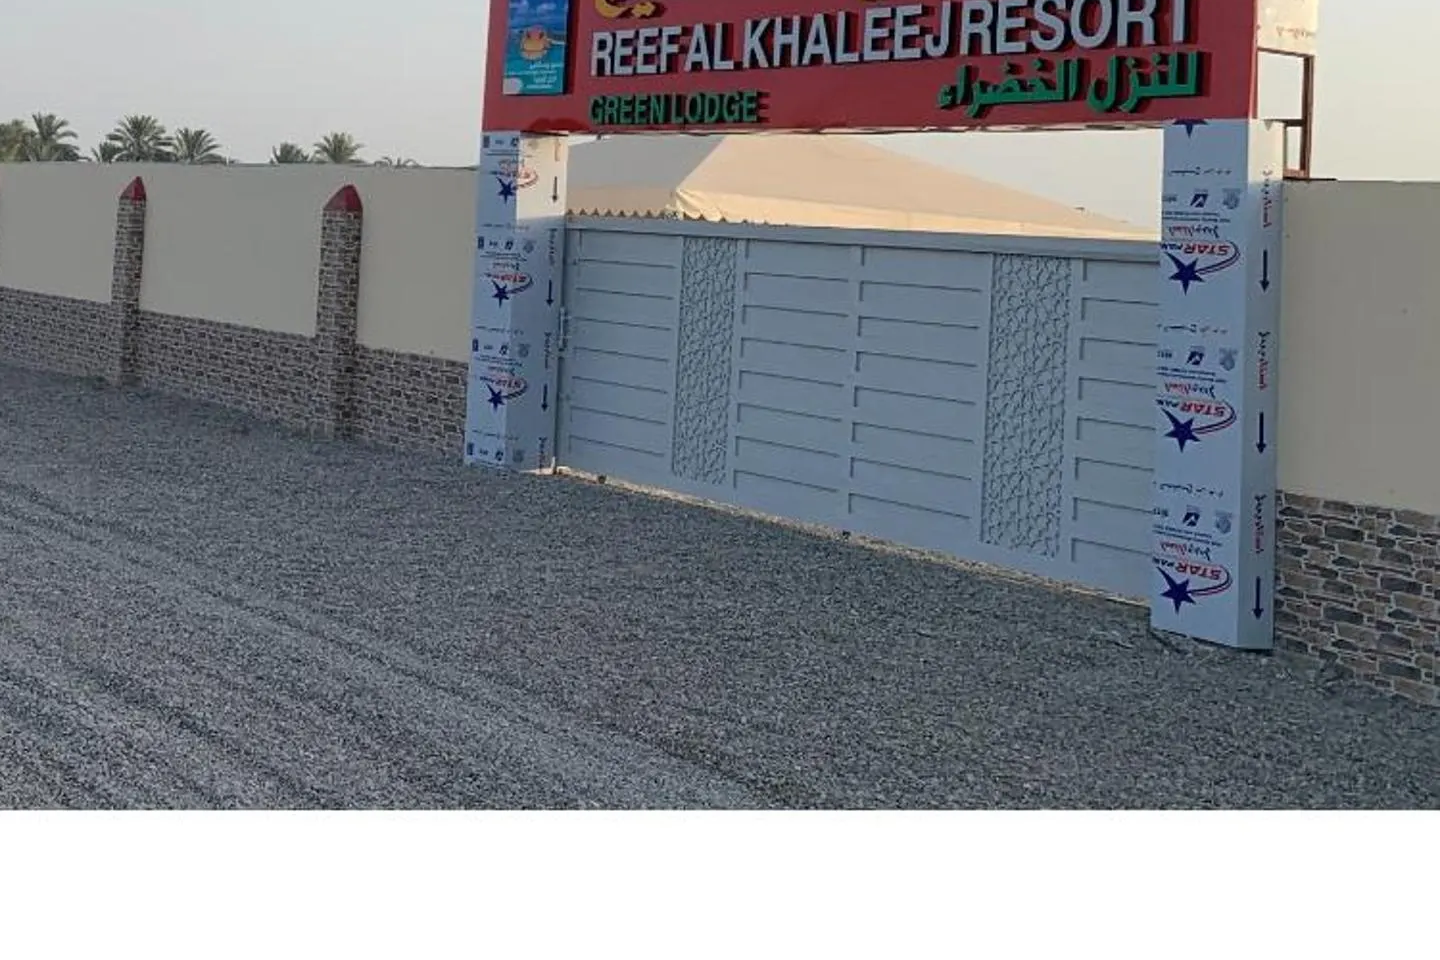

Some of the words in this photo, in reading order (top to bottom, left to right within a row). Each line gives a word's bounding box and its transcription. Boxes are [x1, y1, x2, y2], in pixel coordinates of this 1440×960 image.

[590, 25, 682, 77] REEF
[684, 22, 734, 73] AL
[743, 0, 951, 69] KHALEEJ
[938, 57, 1079, 118] الخضراء
[1087, 51, 1198, 113] للنزل
[589, 95, 666, 126] GREEN
[671, 91, 758, 124] LODGE
[1183, 243, 1231, 256] STAR
[1179, 401, 1226, 418] STAR
[1174, 561, 1222, 581] STAR
